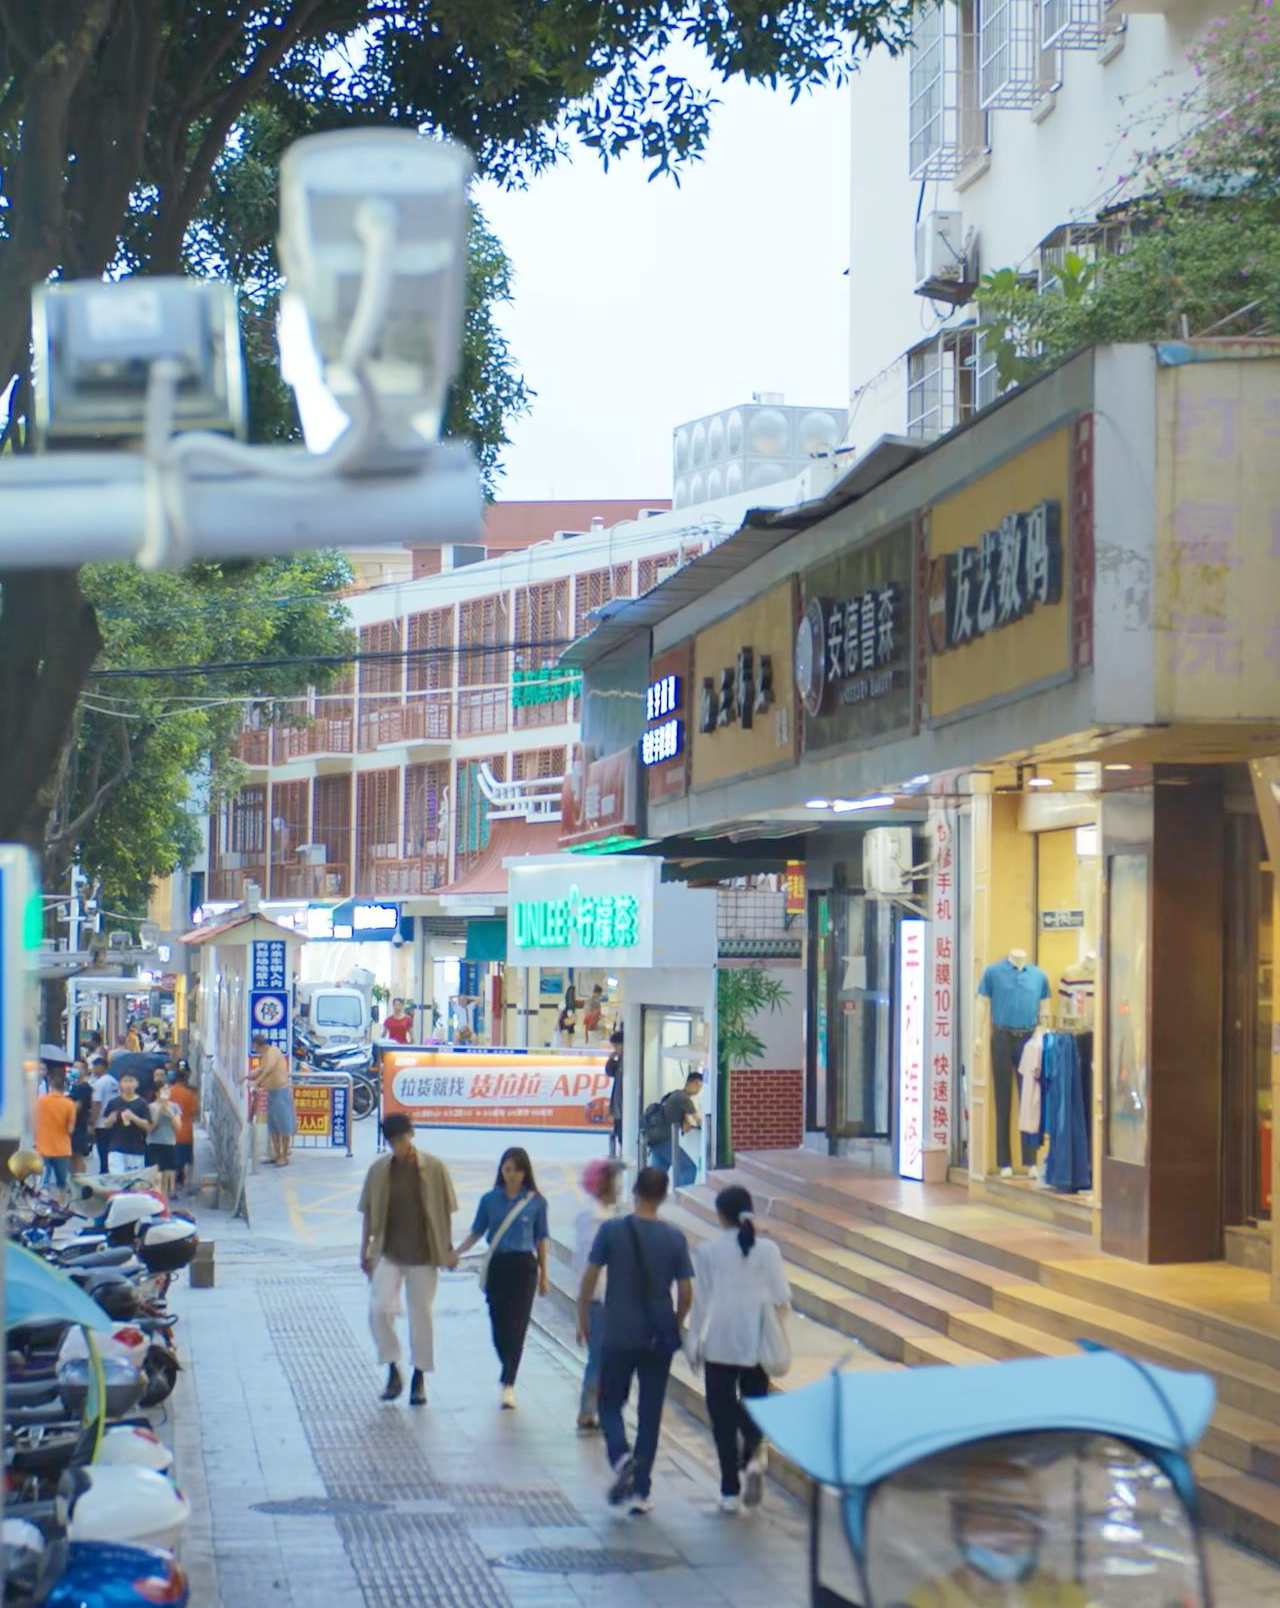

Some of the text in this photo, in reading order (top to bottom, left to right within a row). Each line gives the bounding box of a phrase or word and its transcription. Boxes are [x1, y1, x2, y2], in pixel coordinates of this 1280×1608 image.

[934, 937, 951, 1037] 贴膜10元
[400, 1077, 465, 1098] 拉货就找
[551, 1073, 611, 1098] APP
